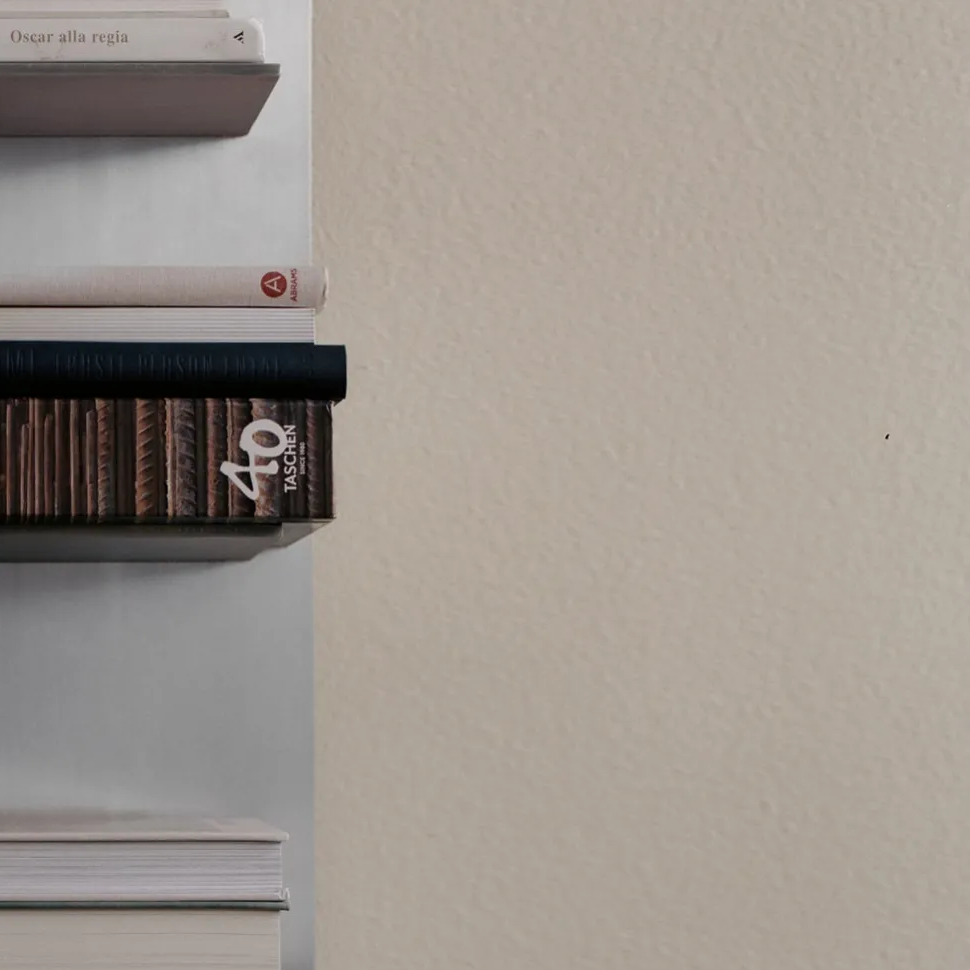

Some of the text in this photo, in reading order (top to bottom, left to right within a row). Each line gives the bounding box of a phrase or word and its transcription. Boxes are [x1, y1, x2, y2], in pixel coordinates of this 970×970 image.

[10, 30, 129, 46] Oscar alla regia
[263, 275, 282, 293] A
[289, 268, 298, 302] ABRAMS
[219, 418, 286, 501] 40
[283, 424, 297, 493] TASCHEN
